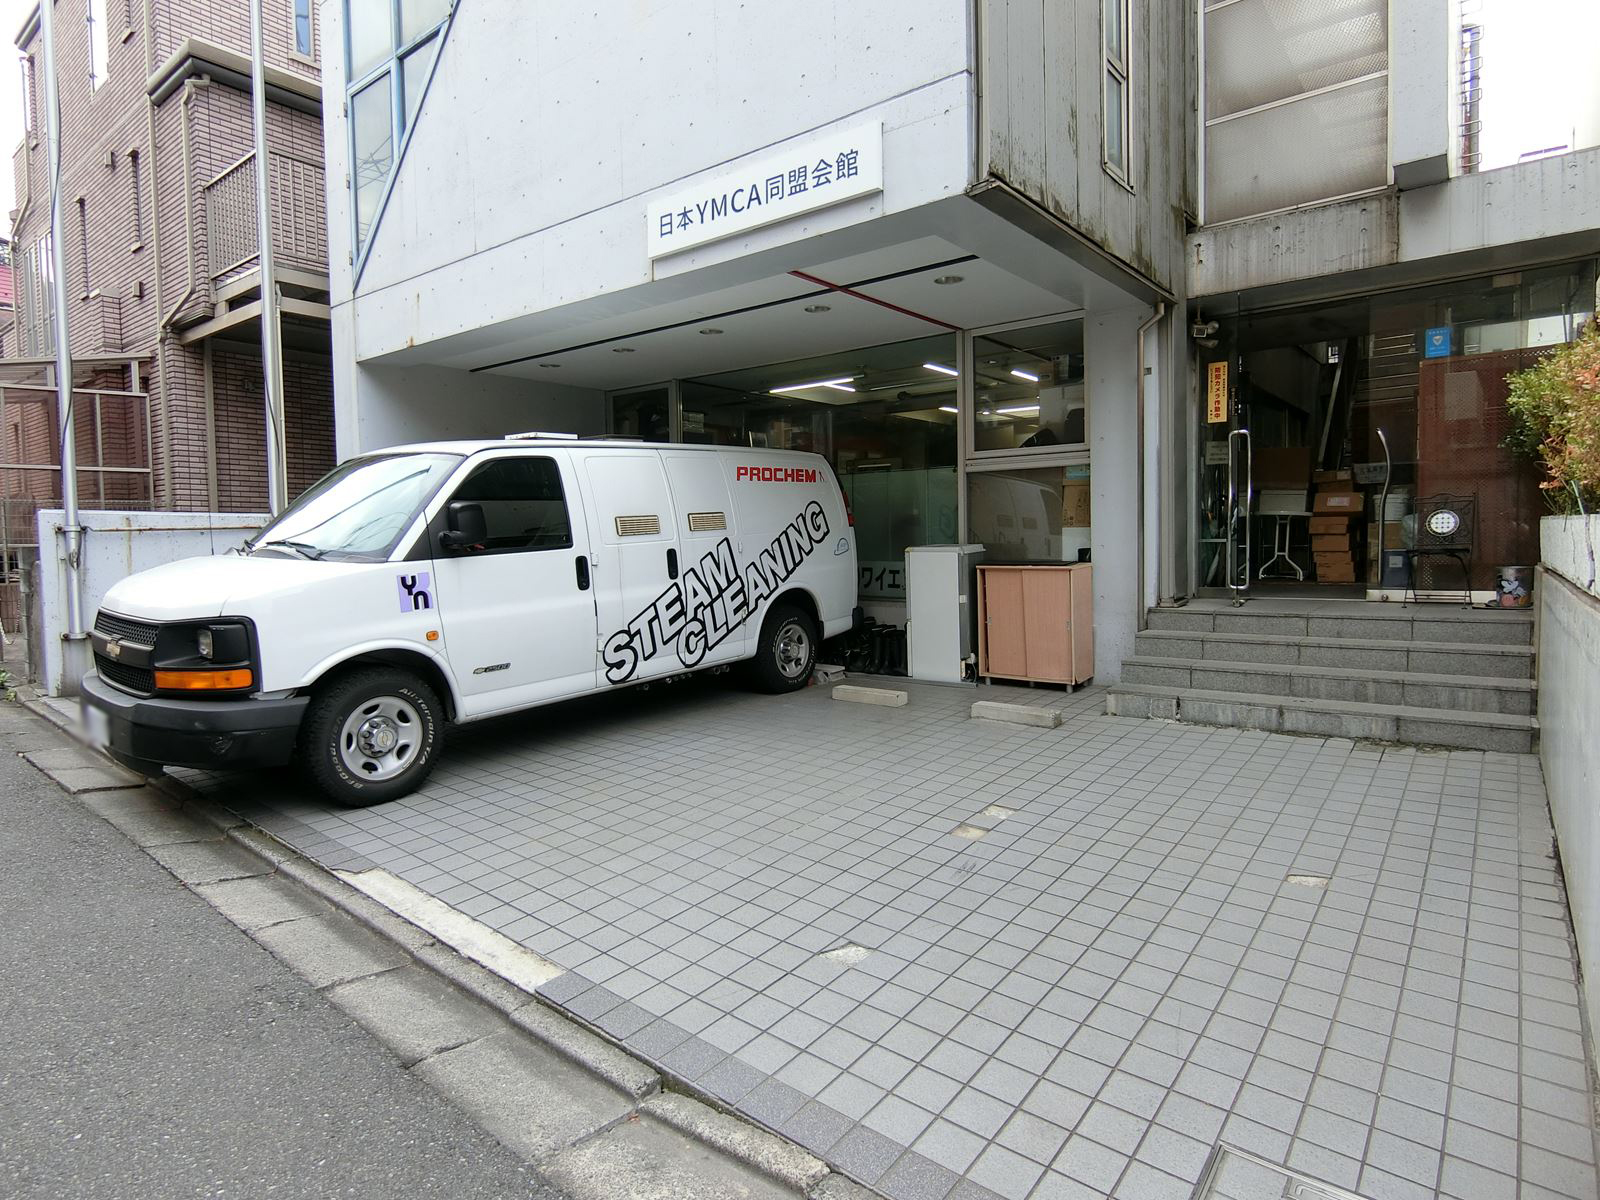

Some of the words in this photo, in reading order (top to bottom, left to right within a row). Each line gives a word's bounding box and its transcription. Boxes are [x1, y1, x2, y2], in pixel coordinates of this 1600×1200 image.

[660, 149, 859, 238] 日本YMCA同盟会館
[736, 466, 817, 483] PROCHEM
[603, 537, 740, 684] STEAM
[676, 501, 830, 668] CLEANING
[861, 567, 905, 591] ワイエ
